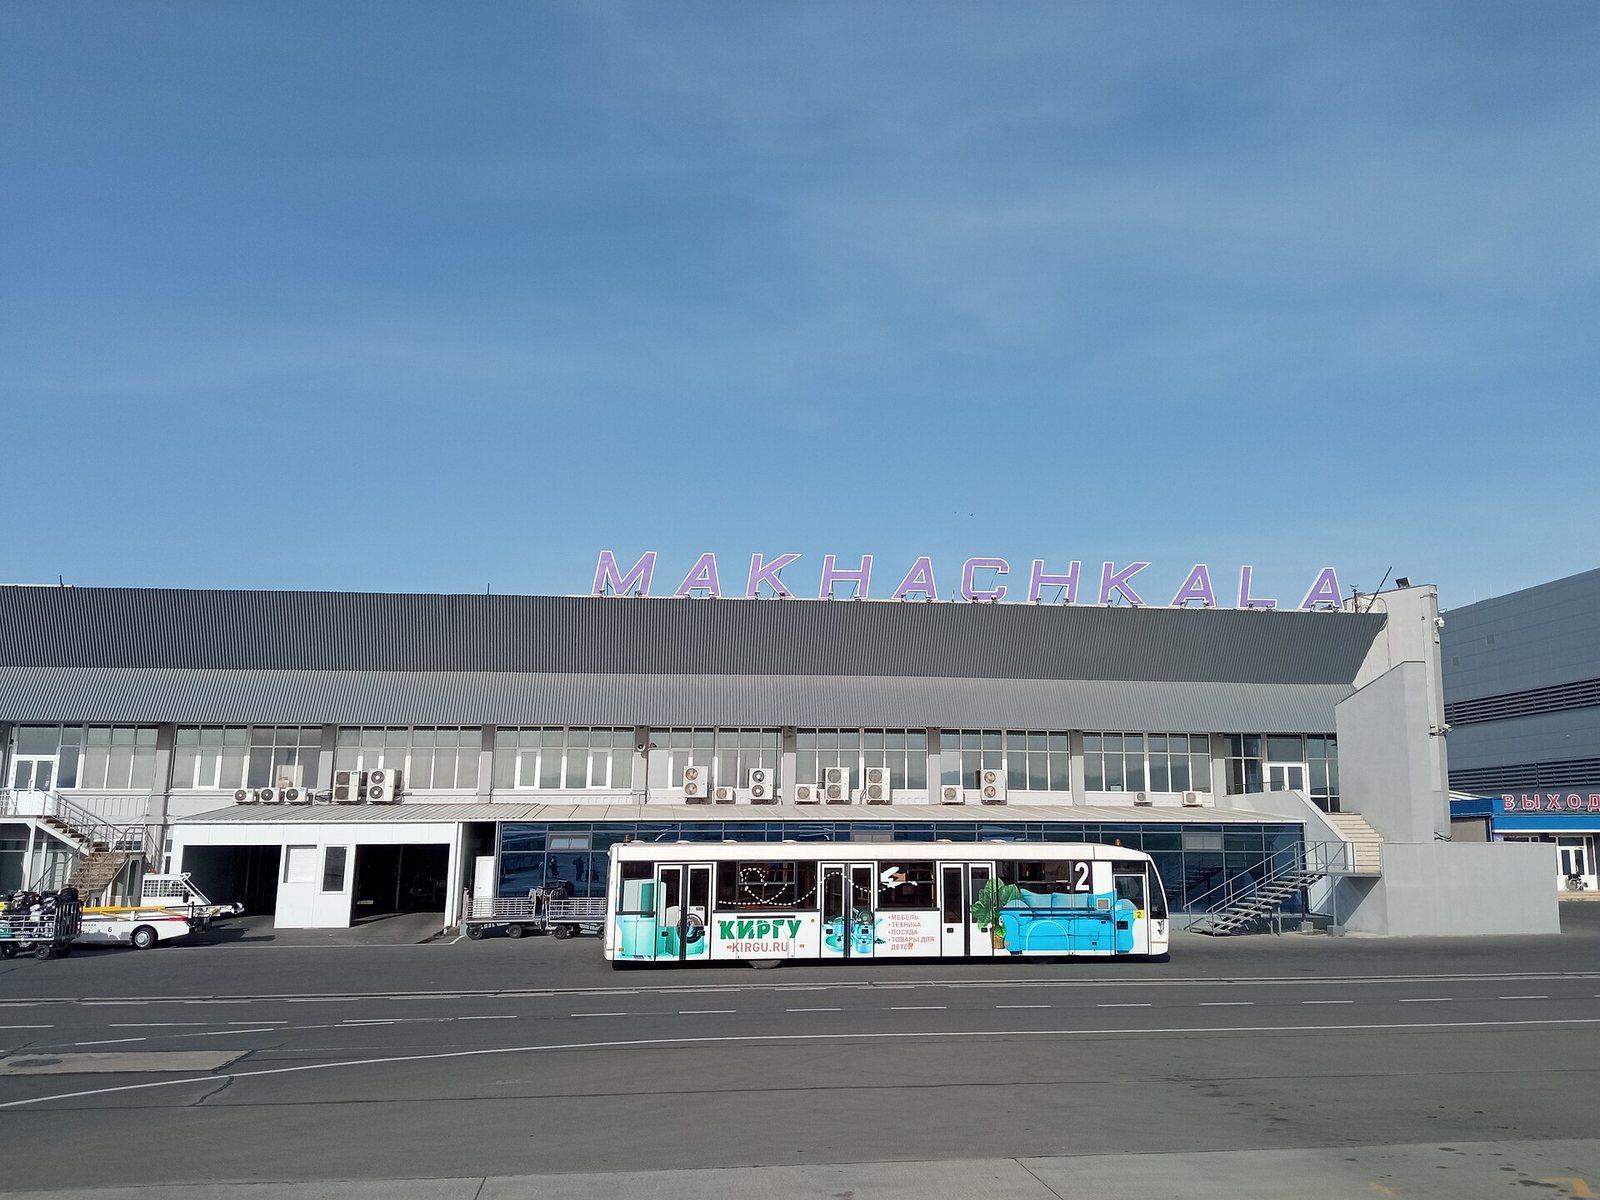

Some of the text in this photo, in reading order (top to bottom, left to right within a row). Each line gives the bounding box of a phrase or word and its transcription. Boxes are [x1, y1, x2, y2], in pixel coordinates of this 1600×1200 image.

[591, 550, 1345, 611] MAKHACHKALA
[1501, 793, 1600, 812] ВЫХОД
[1074, 861, 1089, 891] 2
[1136, 911, 1142, 919] 2
[720, 919, 802, 939] КИРГУ
[732, 942, 788, 952] KIRGU.RU
